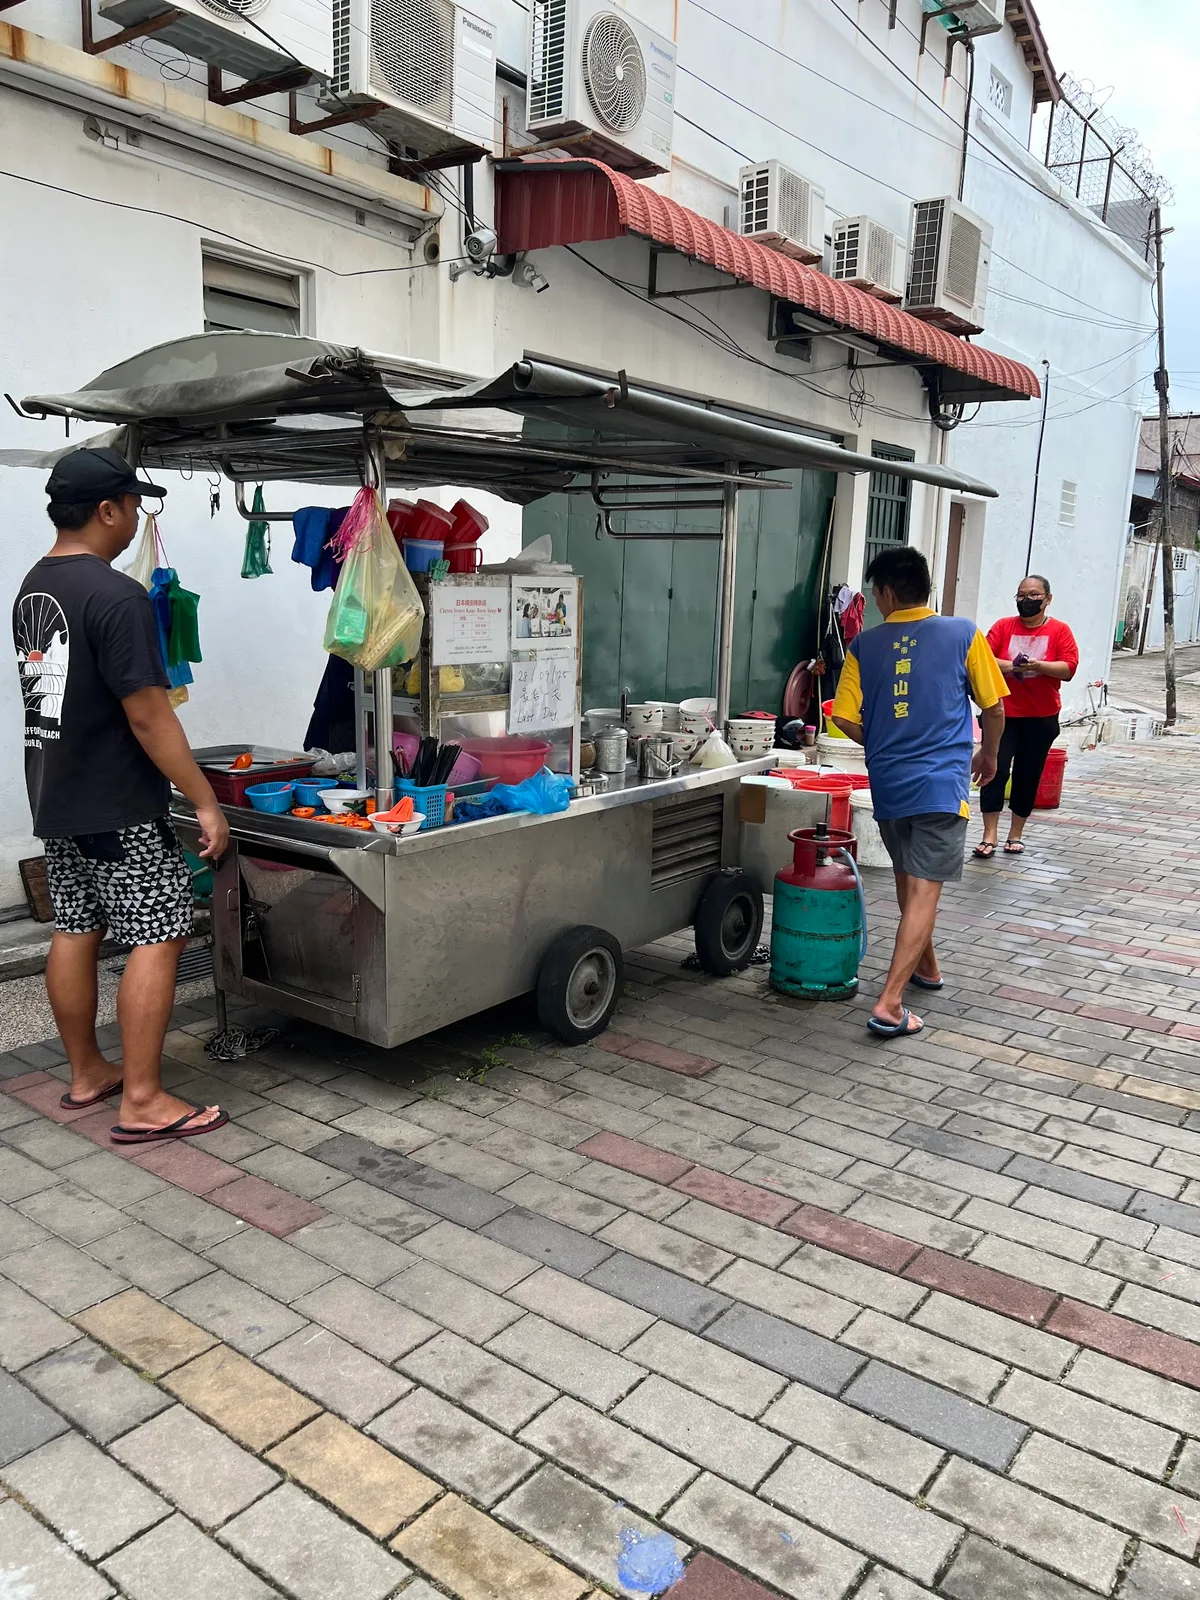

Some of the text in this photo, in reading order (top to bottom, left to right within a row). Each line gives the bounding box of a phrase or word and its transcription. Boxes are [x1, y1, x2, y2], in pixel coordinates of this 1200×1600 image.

[462, 16, 492, 39] Panasonic
[650, 41, 674, 63] Panasonic
[517, 706, 558, 723] Last Day
